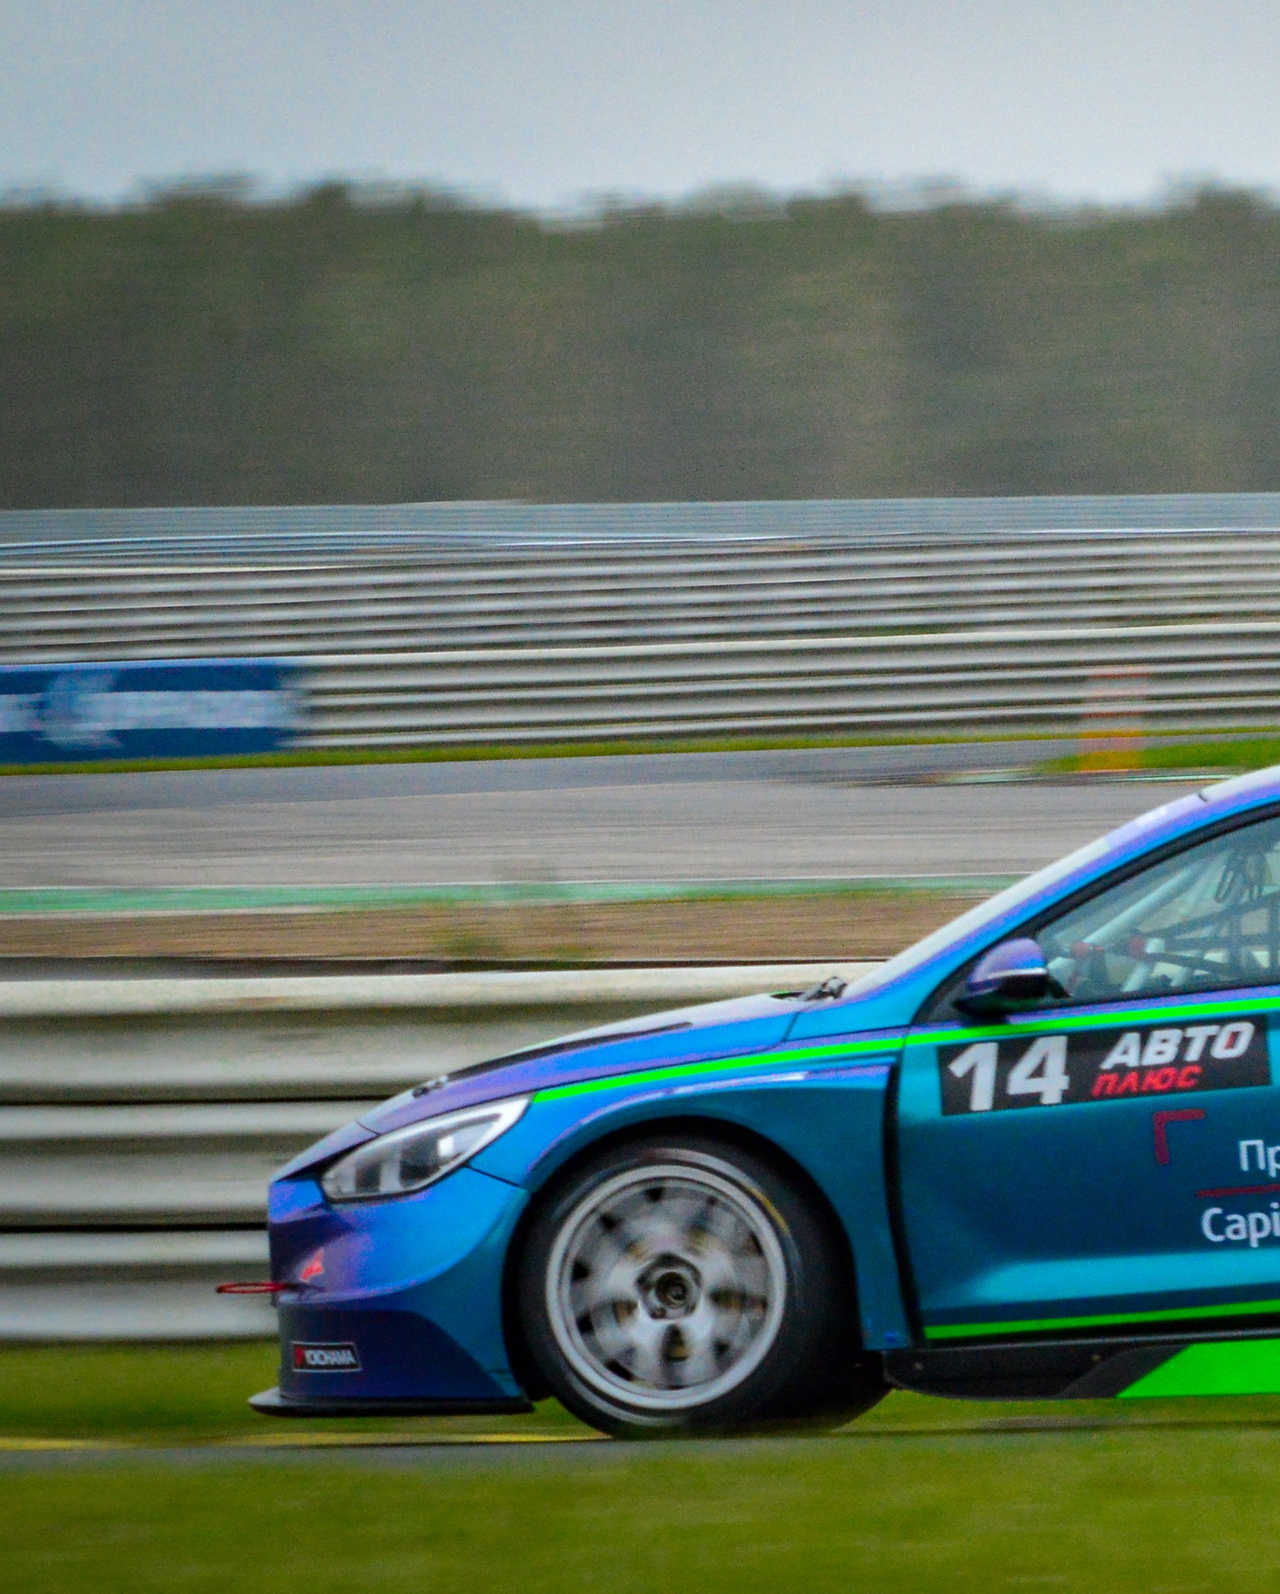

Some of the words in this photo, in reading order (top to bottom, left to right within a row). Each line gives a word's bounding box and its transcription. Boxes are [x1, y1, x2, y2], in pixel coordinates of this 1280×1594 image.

[1100, 1021, 1255, 1070] АВТО
[947, 1034, 1070, 1111] 14
[1091, 1065, 1203, 1097] ПЛЮС
